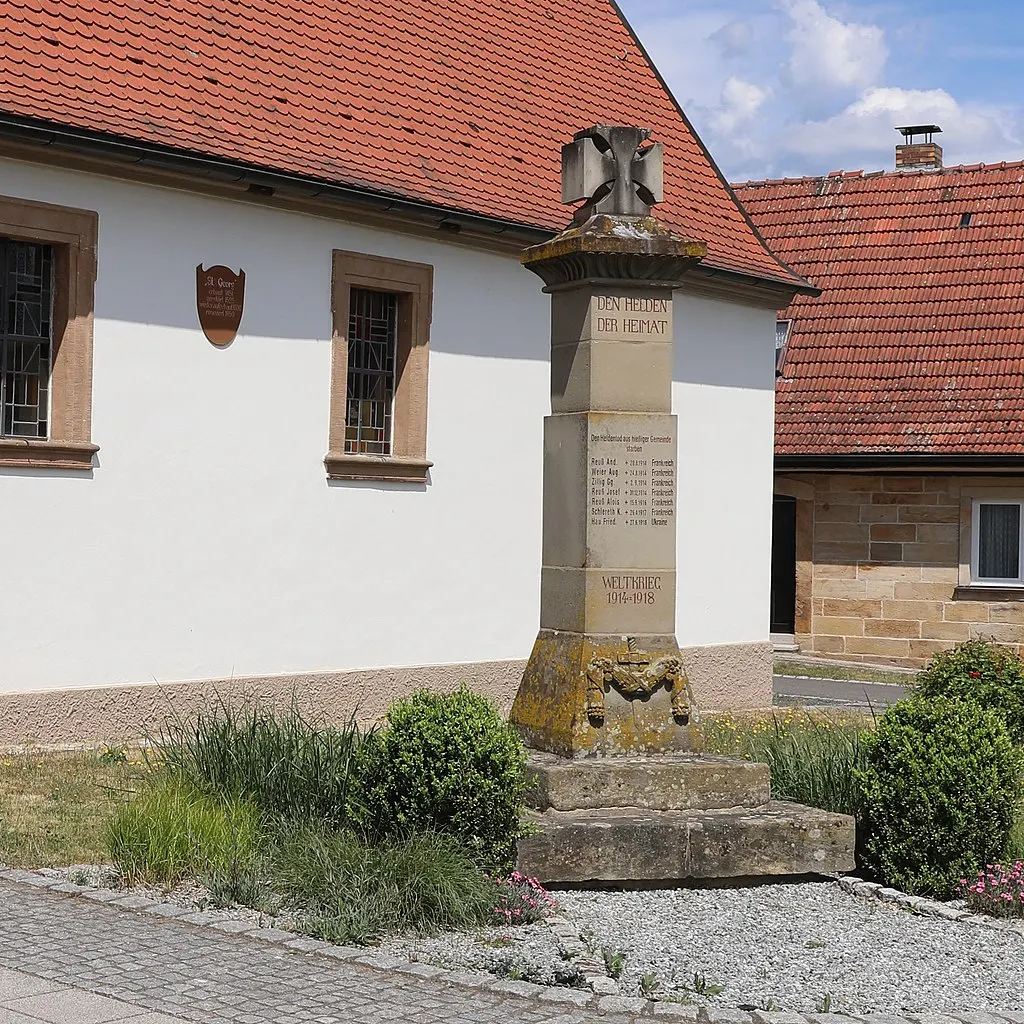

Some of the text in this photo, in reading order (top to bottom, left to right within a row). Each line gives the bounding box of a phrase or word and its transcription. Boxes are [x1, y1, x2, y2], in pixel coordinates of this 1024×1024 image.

[597, 296, 668, 313] DEN HELDEN
[597, 317, 668, 334] DER HEIMAT
[623, 435, 631, 443] aus
[650, 435, 672, 444] Gemeinde
[602, 576, 661, 591] WELTKRIEG
